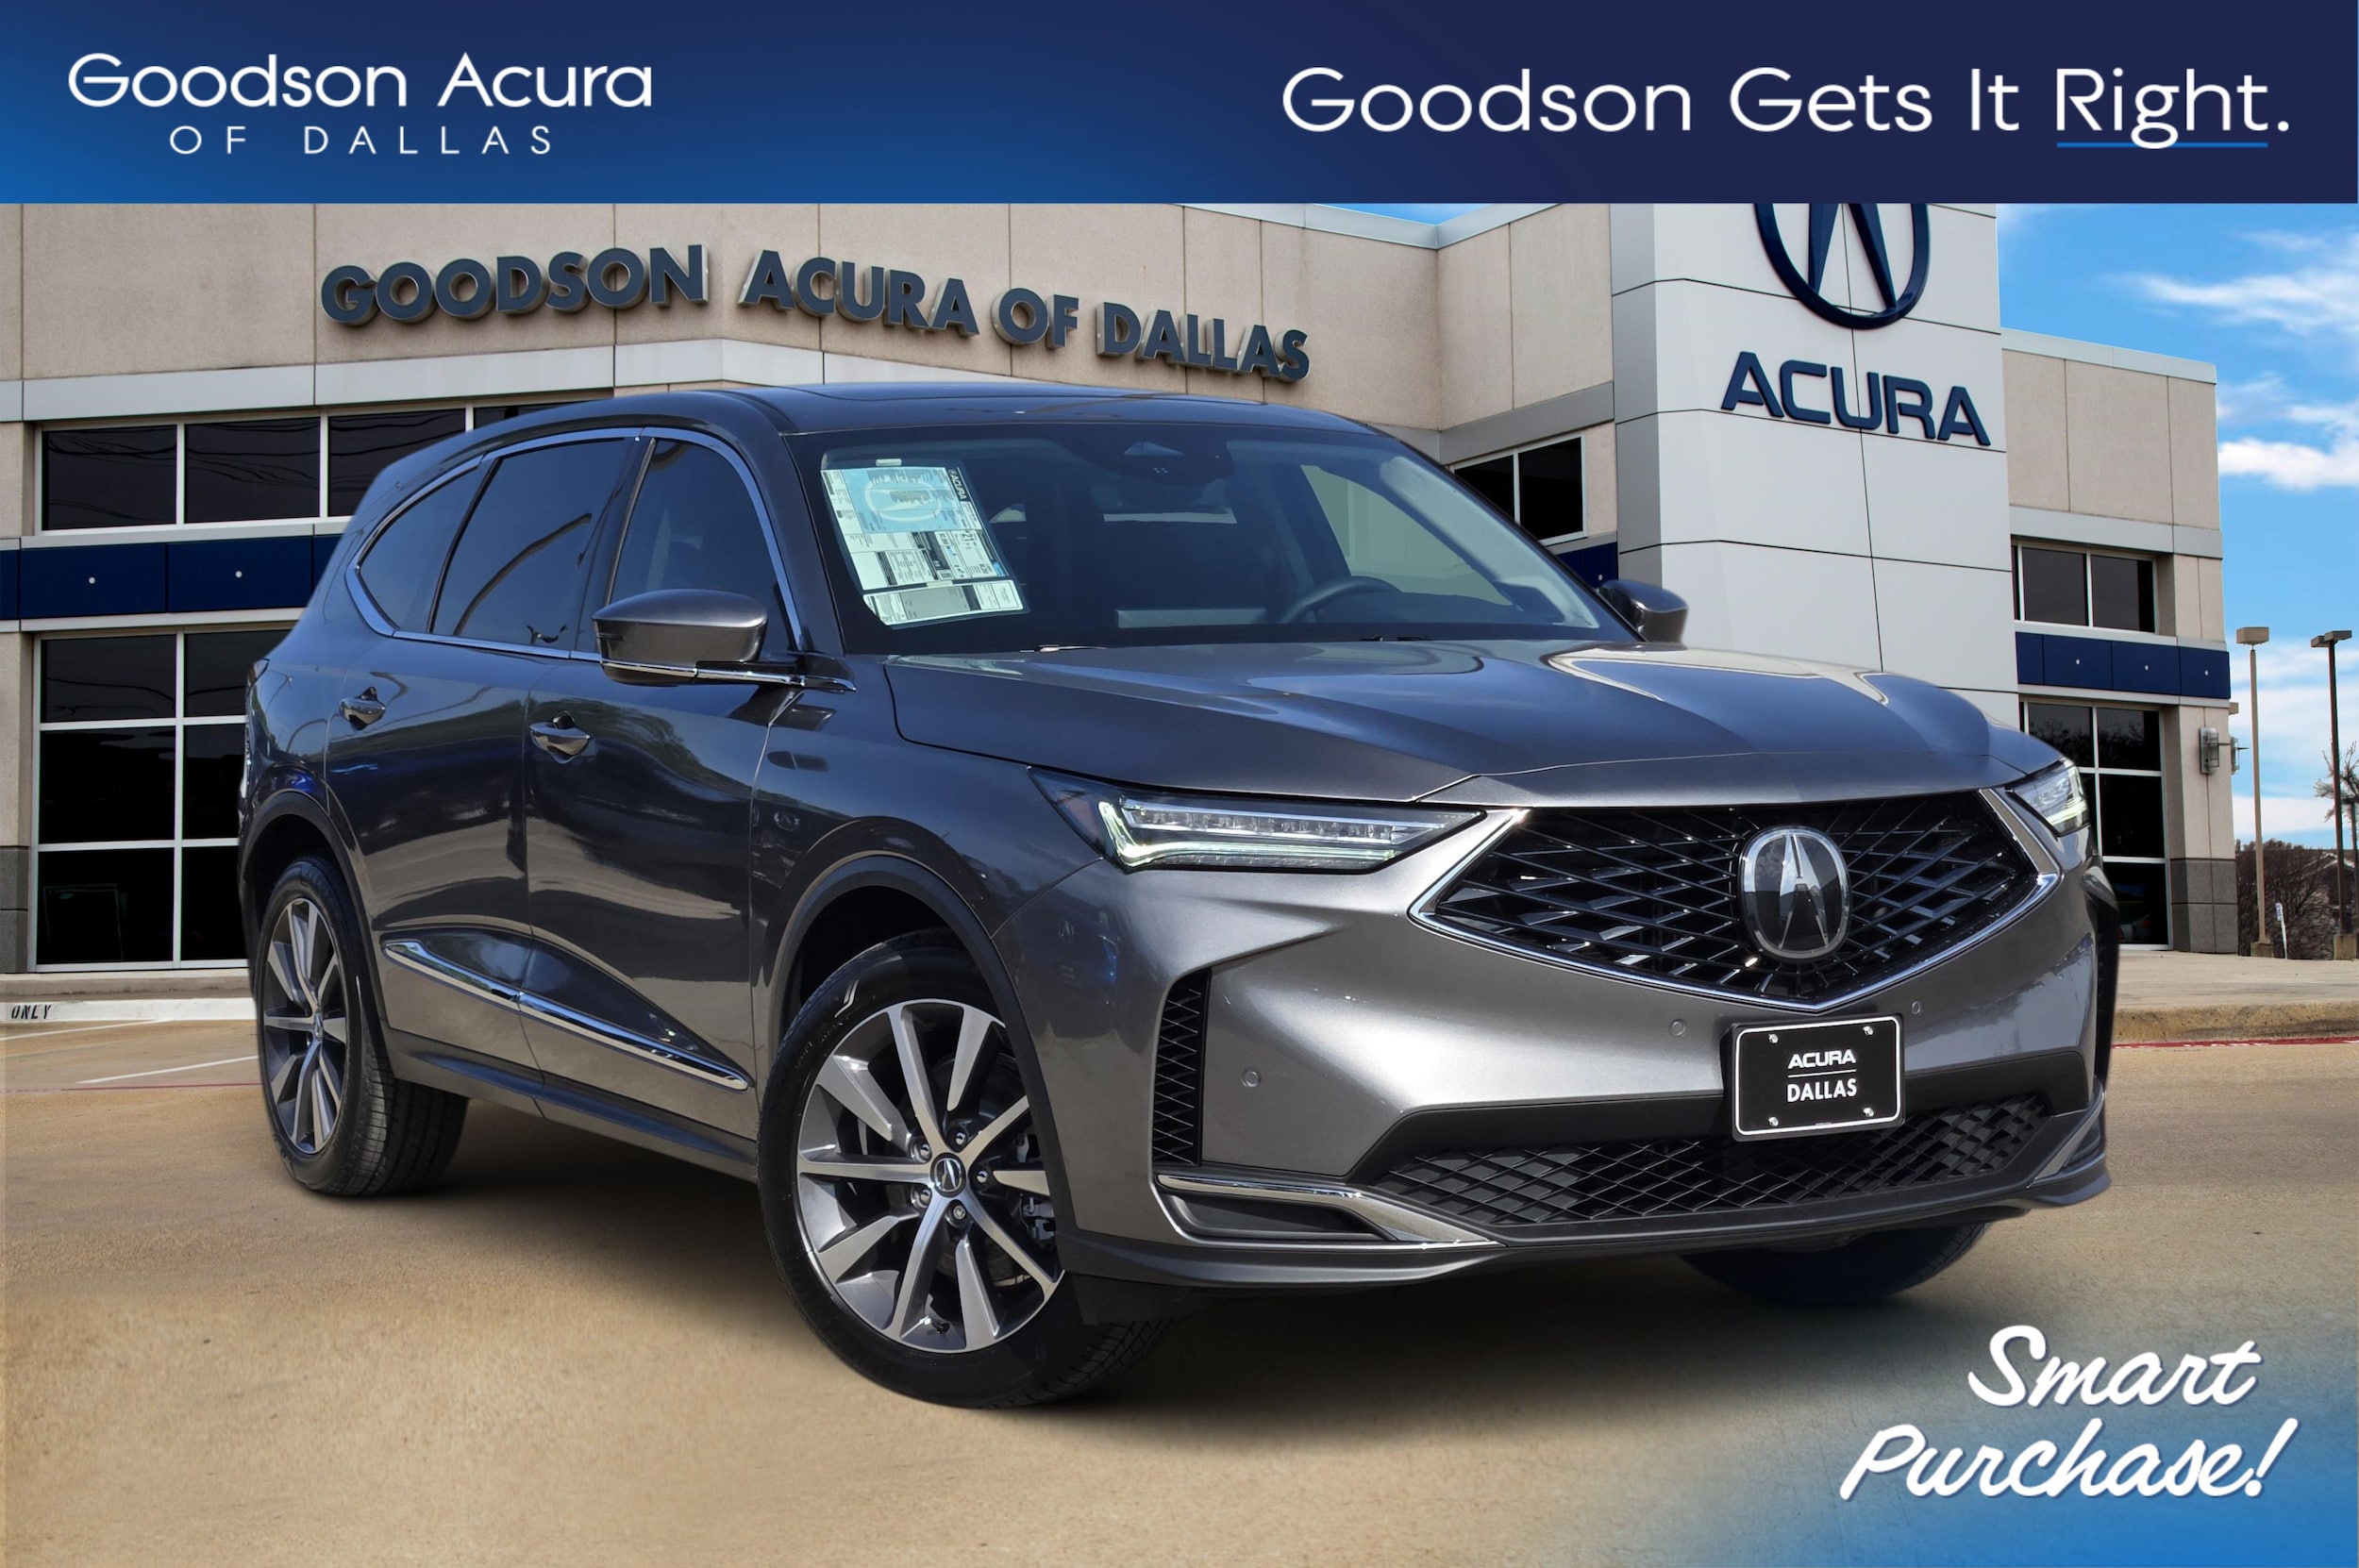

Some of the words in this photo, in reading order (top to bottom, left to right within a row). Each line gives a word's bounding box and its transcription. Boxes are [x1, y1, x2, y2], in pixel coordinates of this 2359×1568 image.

[321, 243, 710, 326] GOODSON
[738, 249, 979, 337] ACURA
[992, 288, 1079, 349] OF
[1096, 301, 1310, 381] DALLAS
[1720, 351, 1991, 446] ACURA
[10, 1004, 52, 1020] ONLY
[1787, 1049, 1857, 1069] ACURA
[1787, 1077, 1858, 1103] DALLAS
